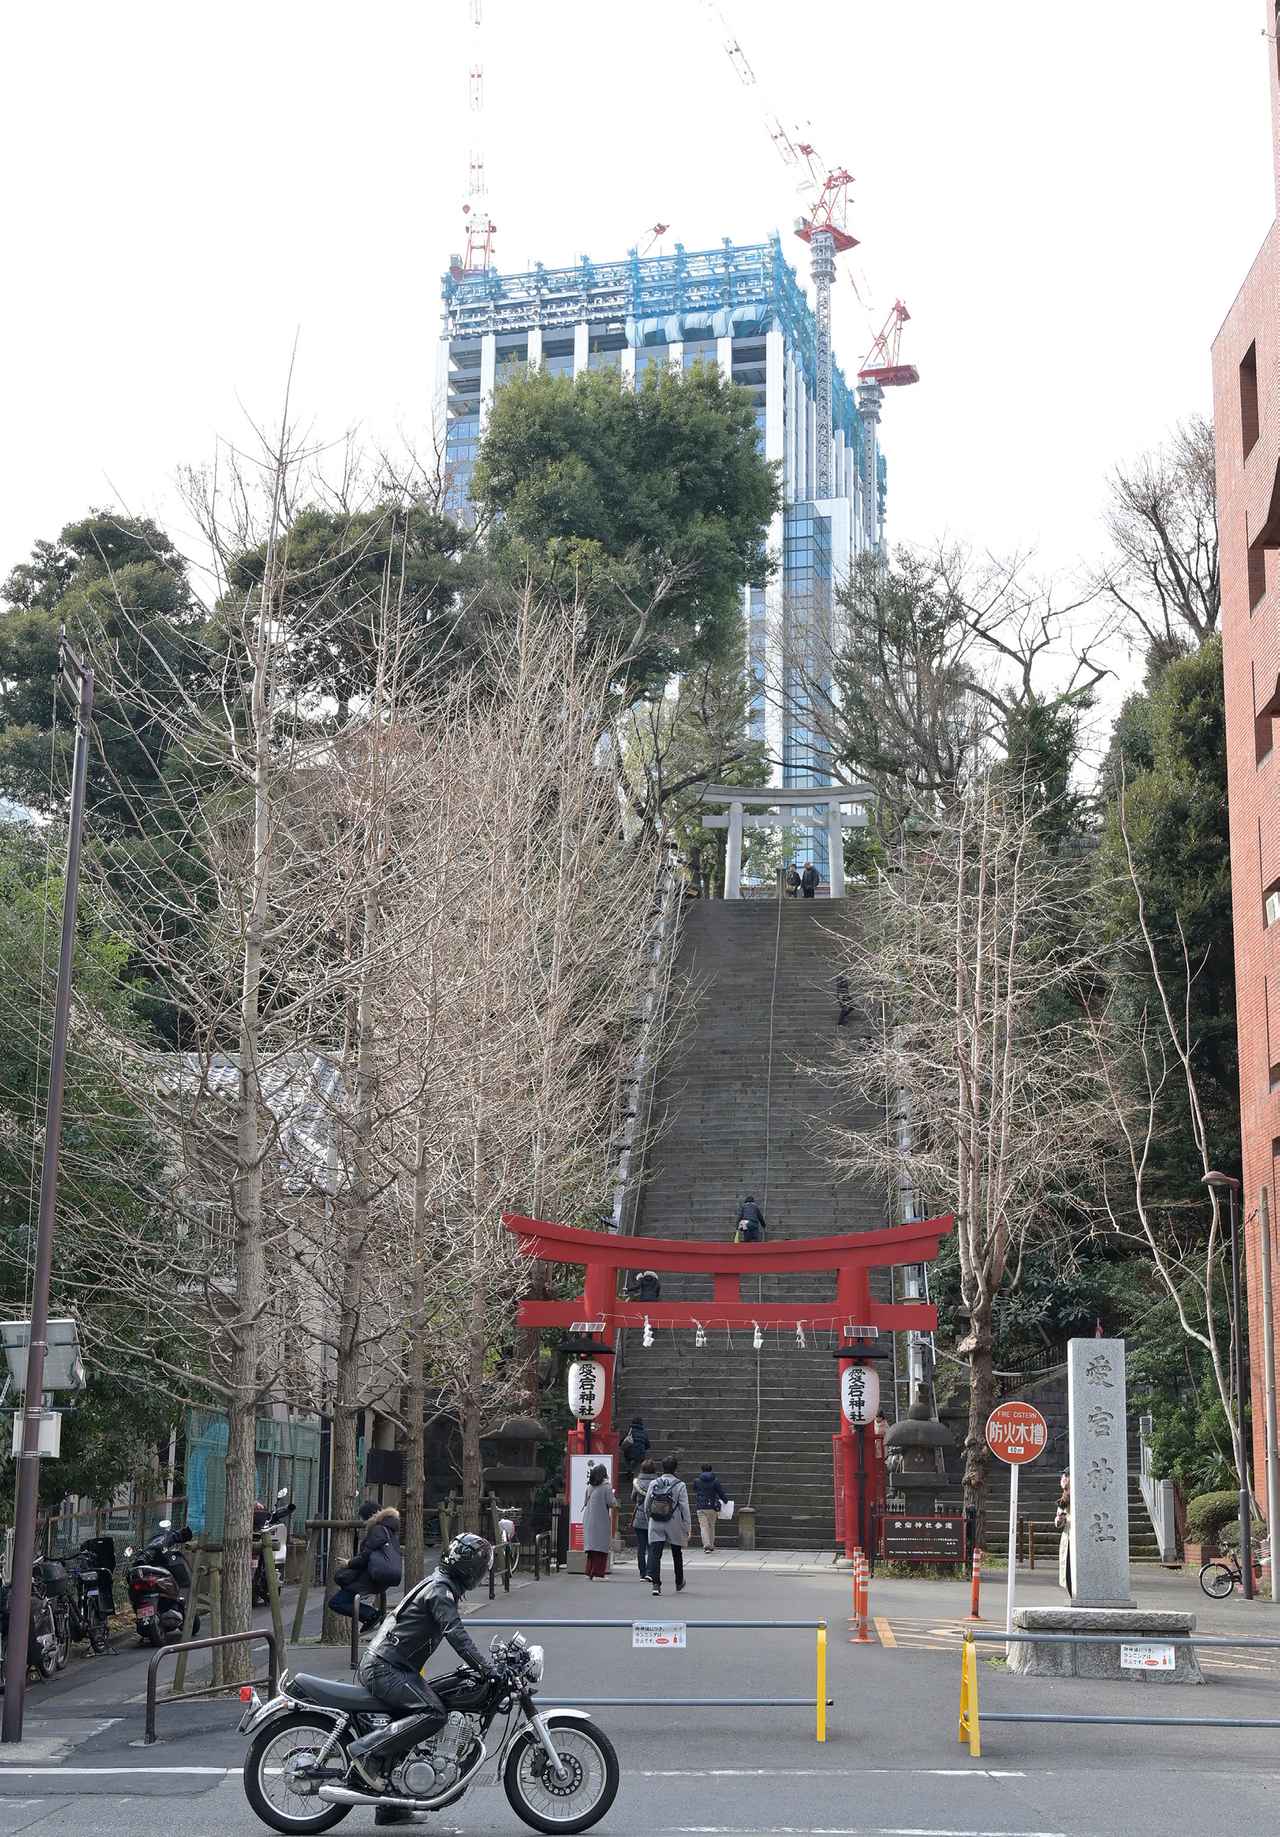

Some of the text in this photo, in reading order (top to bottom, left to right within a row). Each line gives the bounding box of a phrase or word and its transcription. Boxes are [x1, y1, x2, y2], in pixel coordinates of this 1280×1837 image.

[578, 1363, 597, 1416] 愛宕神社
[848, 1368, 866, 1422] 愛宕神社
[1085, 1354, 1117, 1543] 愛宕神社
